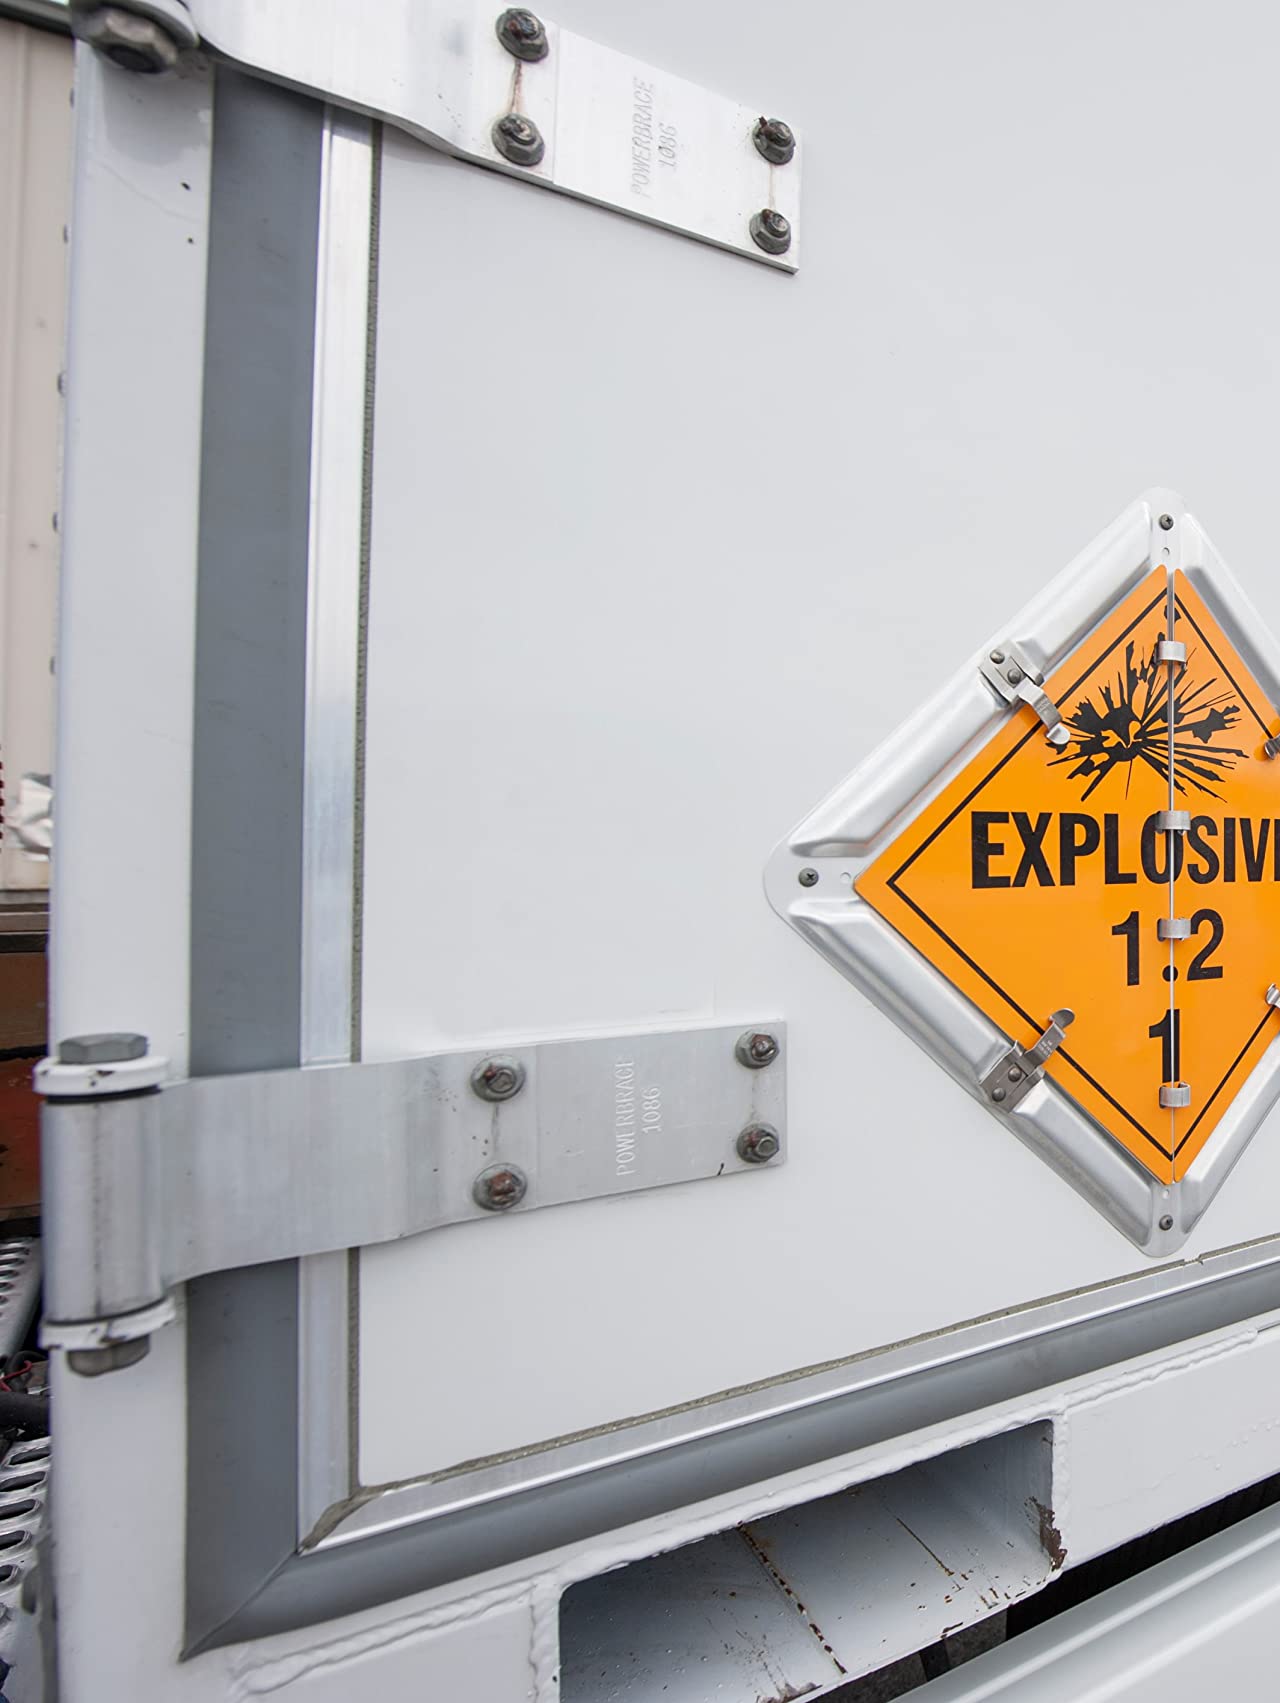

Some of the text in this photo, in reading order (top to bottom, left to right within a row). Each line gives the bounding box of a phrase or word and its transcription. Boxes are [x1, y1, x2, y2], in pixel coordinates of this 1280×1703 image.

[631, 76, 656, 200] POWERBRACE
[657, 121, 679, 172] 1086
[1111, 908, 1224, 986] 1.2
[1148, 1008, 1180, 1083] 1
[641, 1086, 662, 1134] 1086
